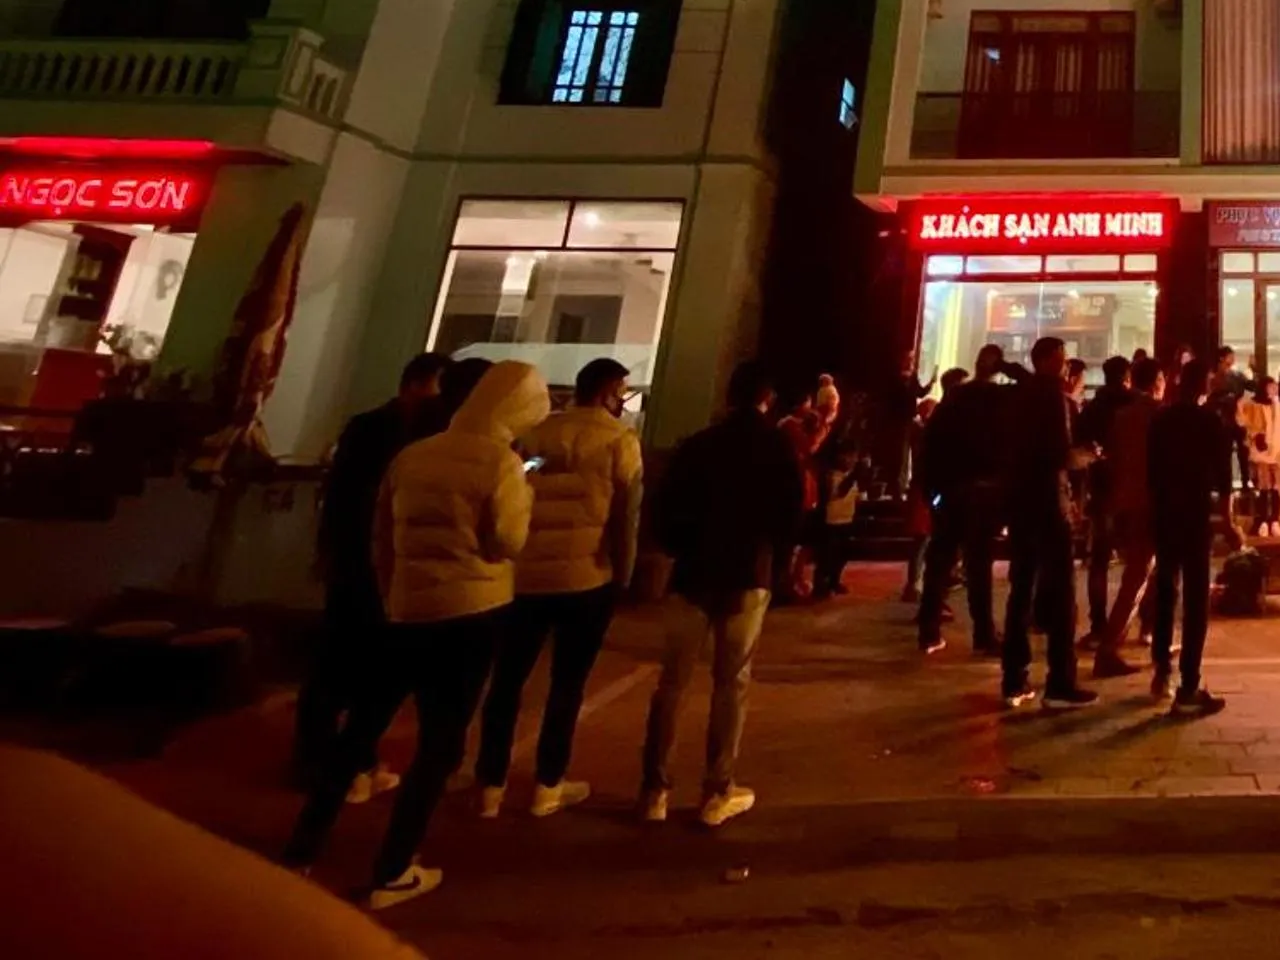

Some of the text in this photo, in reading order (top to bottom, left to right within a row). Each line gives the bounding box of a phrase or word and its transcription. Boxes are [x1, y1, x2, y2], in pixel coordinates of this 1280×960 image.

[0, 177, 190, 215] NGỌC SƠN
[920, 205, 1163, 244] KHÁCH SẠN ANH MINH
